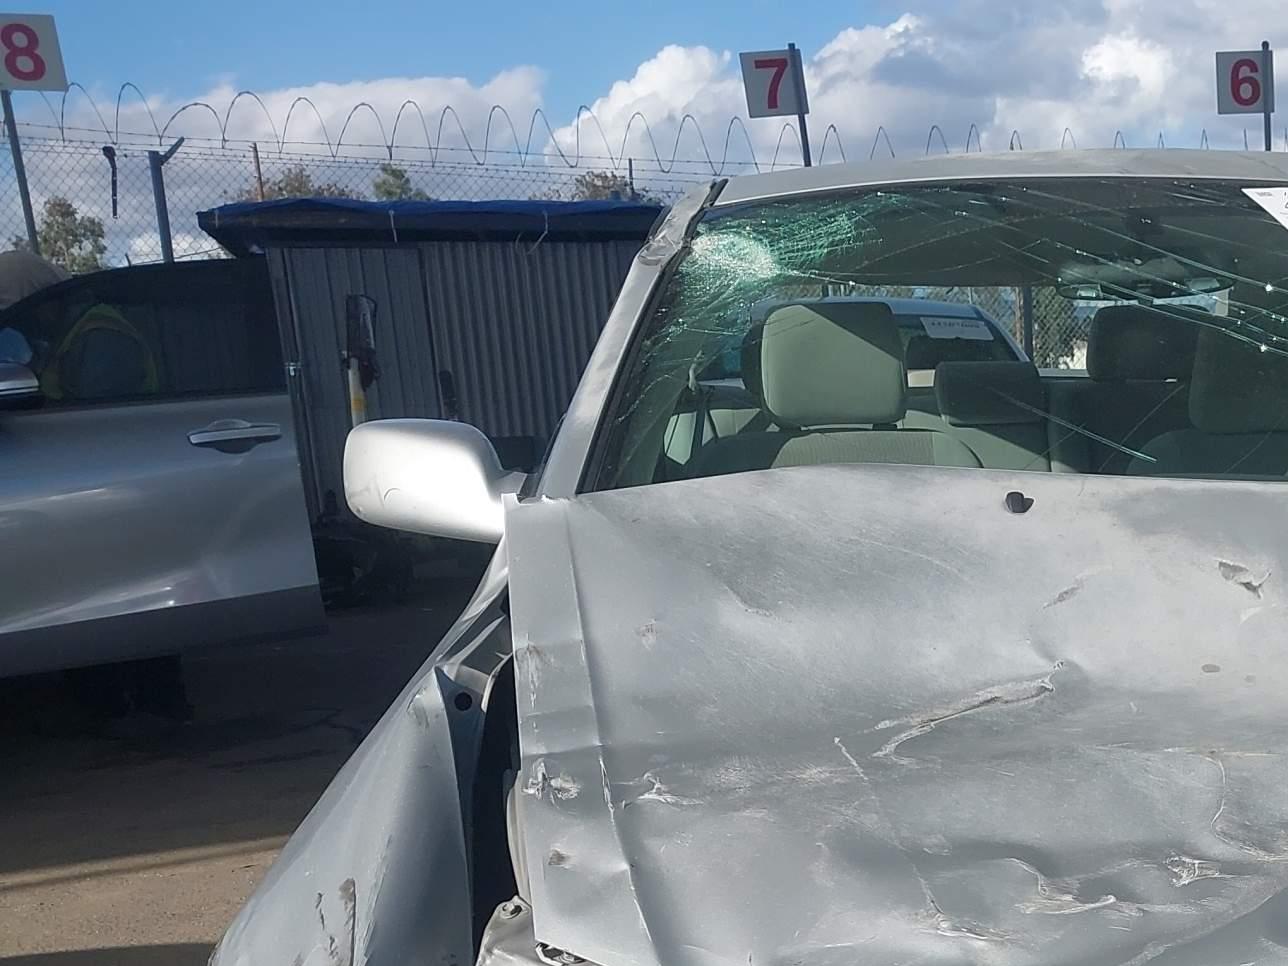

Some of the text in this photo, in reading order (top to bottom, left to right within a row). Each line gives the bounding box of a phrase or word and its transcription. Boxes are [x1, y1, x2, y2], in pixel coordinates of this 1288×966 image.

[1, 24, 46, 81] 8
[754, 58, 788, 109] 7
[1231, 59, 1260, 106] 6
